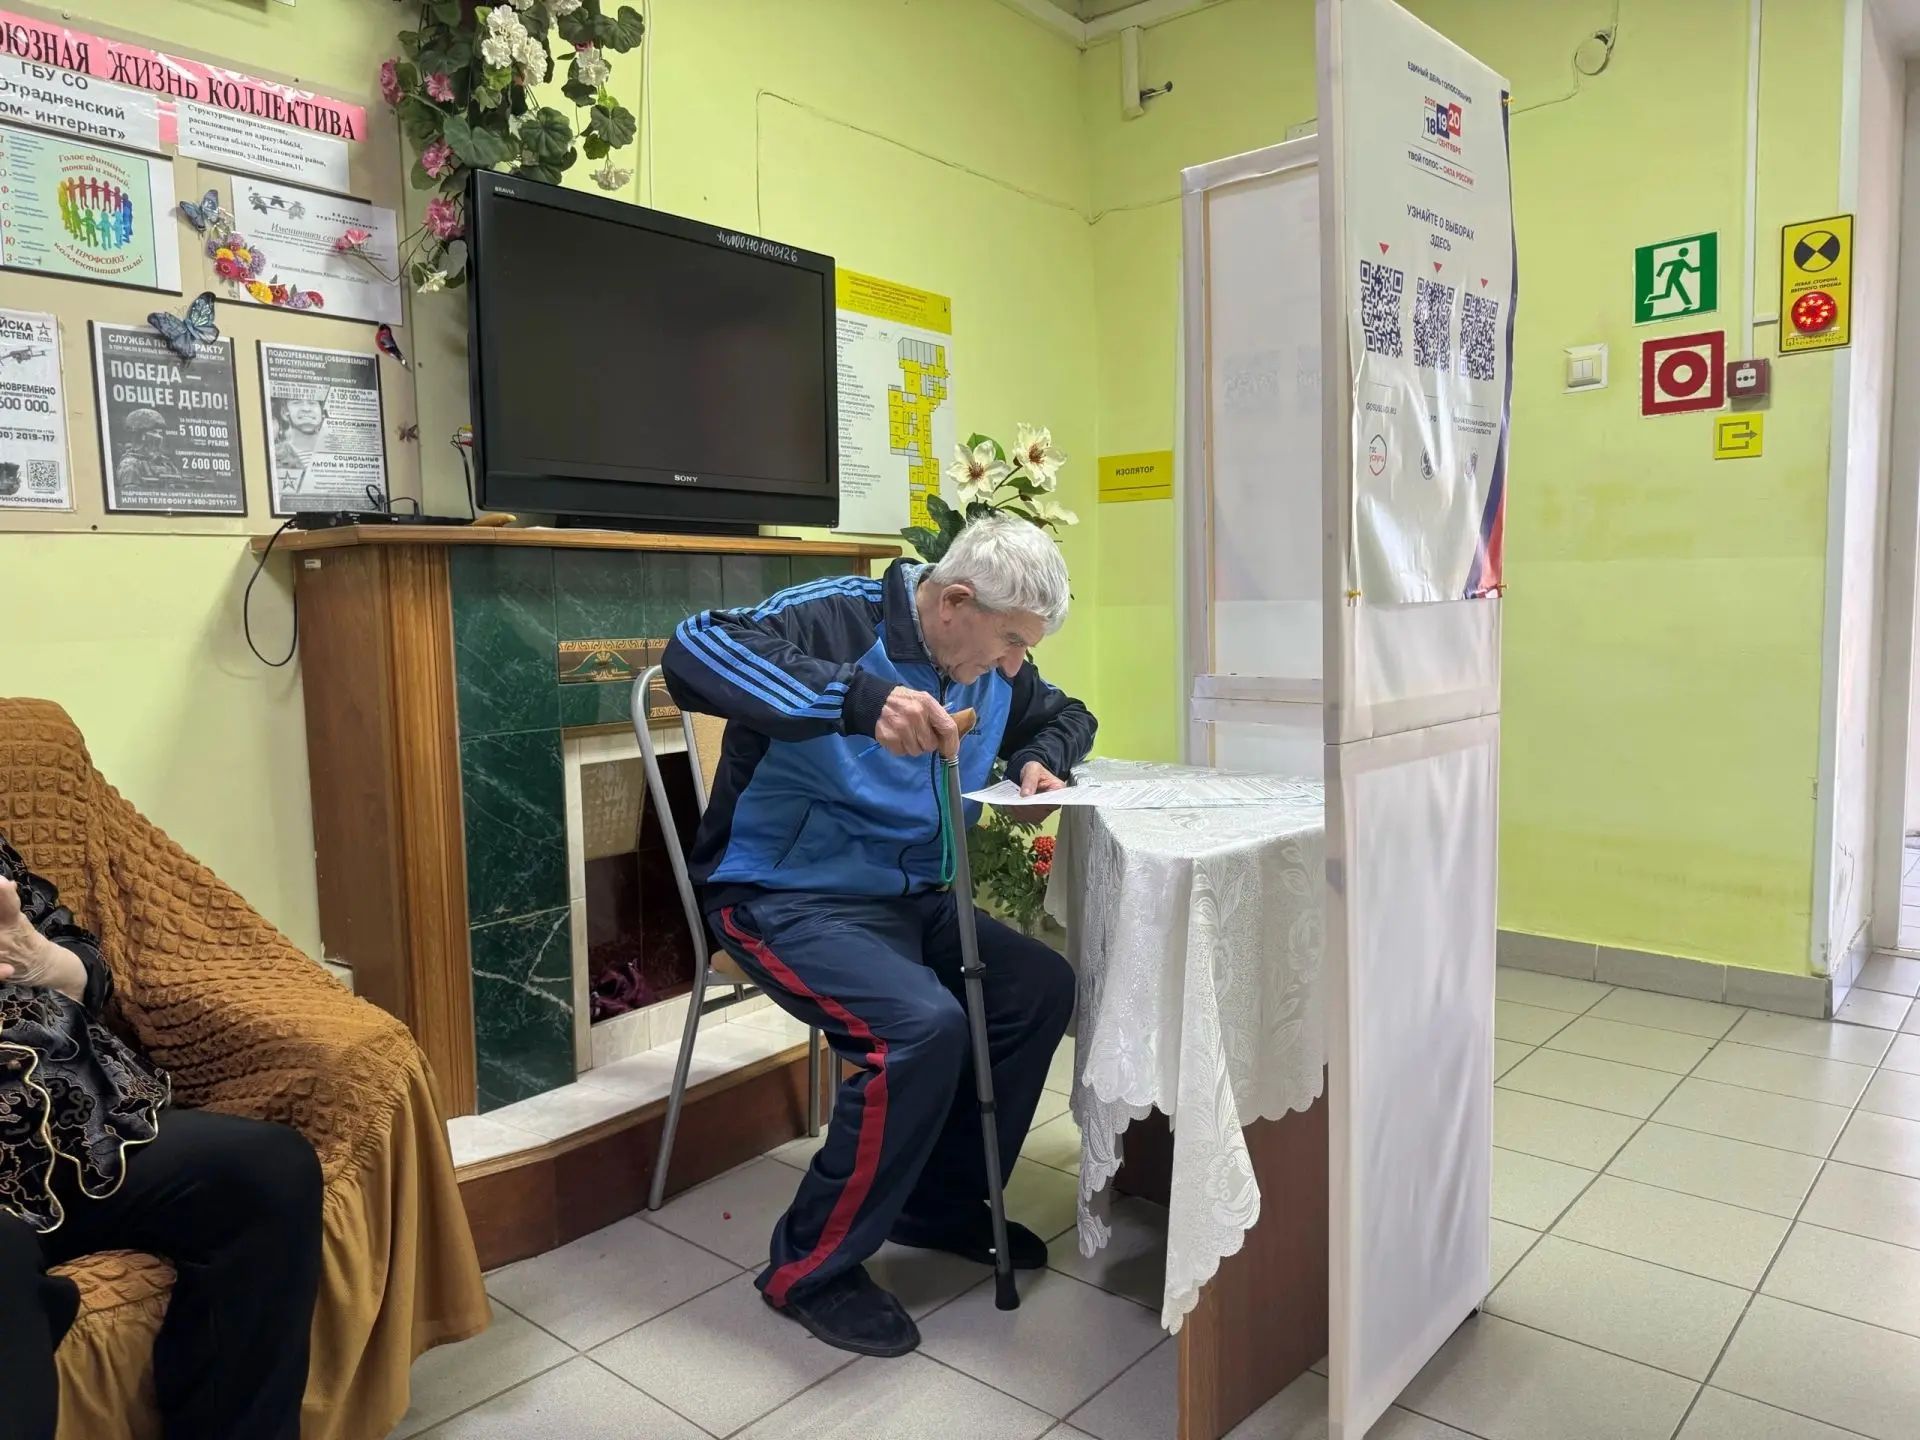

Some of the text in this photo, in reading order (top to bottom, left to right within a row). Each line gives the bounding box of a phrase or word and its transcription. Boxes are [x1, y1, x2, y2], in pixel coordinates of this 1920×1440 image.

[21, 61, 88, 90] ГБУ СО
[1408, 60, 1429, 78] ЕДИНЫЙ
[1429, 72, 1441, 86] ДЕНЬ
[108, 49, 198, 100] ЖИЗНЬ
[207, 76, 356, 140] КОЛЛЕКТИВА
[188, 103, 235, 121] Структурное
[35, 109, 126, 141] интернат»
[188, 117, 243, 135] расположенное
[1426, 109, 1460, 136] 18 19 20
[189, 127, 230, 142] Самарская
[198, 140, 246, 158] Максимовка,
[1438, 138, 1462, 156] СЕНТЯБРЯ
[59, 154, 84, 163] Голос
[1408, 150, 1422, 163] ТВОЙ
[1422, 156, 1439, 171] ГОЛОС
[1442, 164, 1455, 178] СИЛА
[1455, 170, 1475, 186] РОССИИ
[1407, 203, 1475, 241] УЗНАЙТЕ О ВЫБОРАХ
[1430, 233, 1452, 252] ЗДЕСЬ
[54, 242, 121, 275] коллективная
[75, 248, 125, 265] ПРОФСОЮЗ
[108, 334, 152, 346] СЛУЖБА
[268, 349, 323, 362] ПОДОЗРЕВАЕМЫЕ
[275, 358, 326, 369] ПРЕСТУПЛЕНИЯХ
[110, 360, 182, 385] ПОБЕДА
[25, 398, 49, 413] 000
[113, 384, 229, 411] ОБЩЕЕ ДЕЛО!
[16, 431, 55, 442] 2019-117
[179, 424, 186, 436] 5
[188, 425, 207, 437] 100
[209, 426, 228, 439] 000
[182, 457, 230, 471] 2 600 000
[1115, 465, 1155, 476] ИЗОЛЯТОР
[674, 474, 698, 482] SONY
[0, 495, 63, 503] ИКОСНОВЕНИЯ
[149, 497, 187, 505] ТЕЛЕФОНУ
